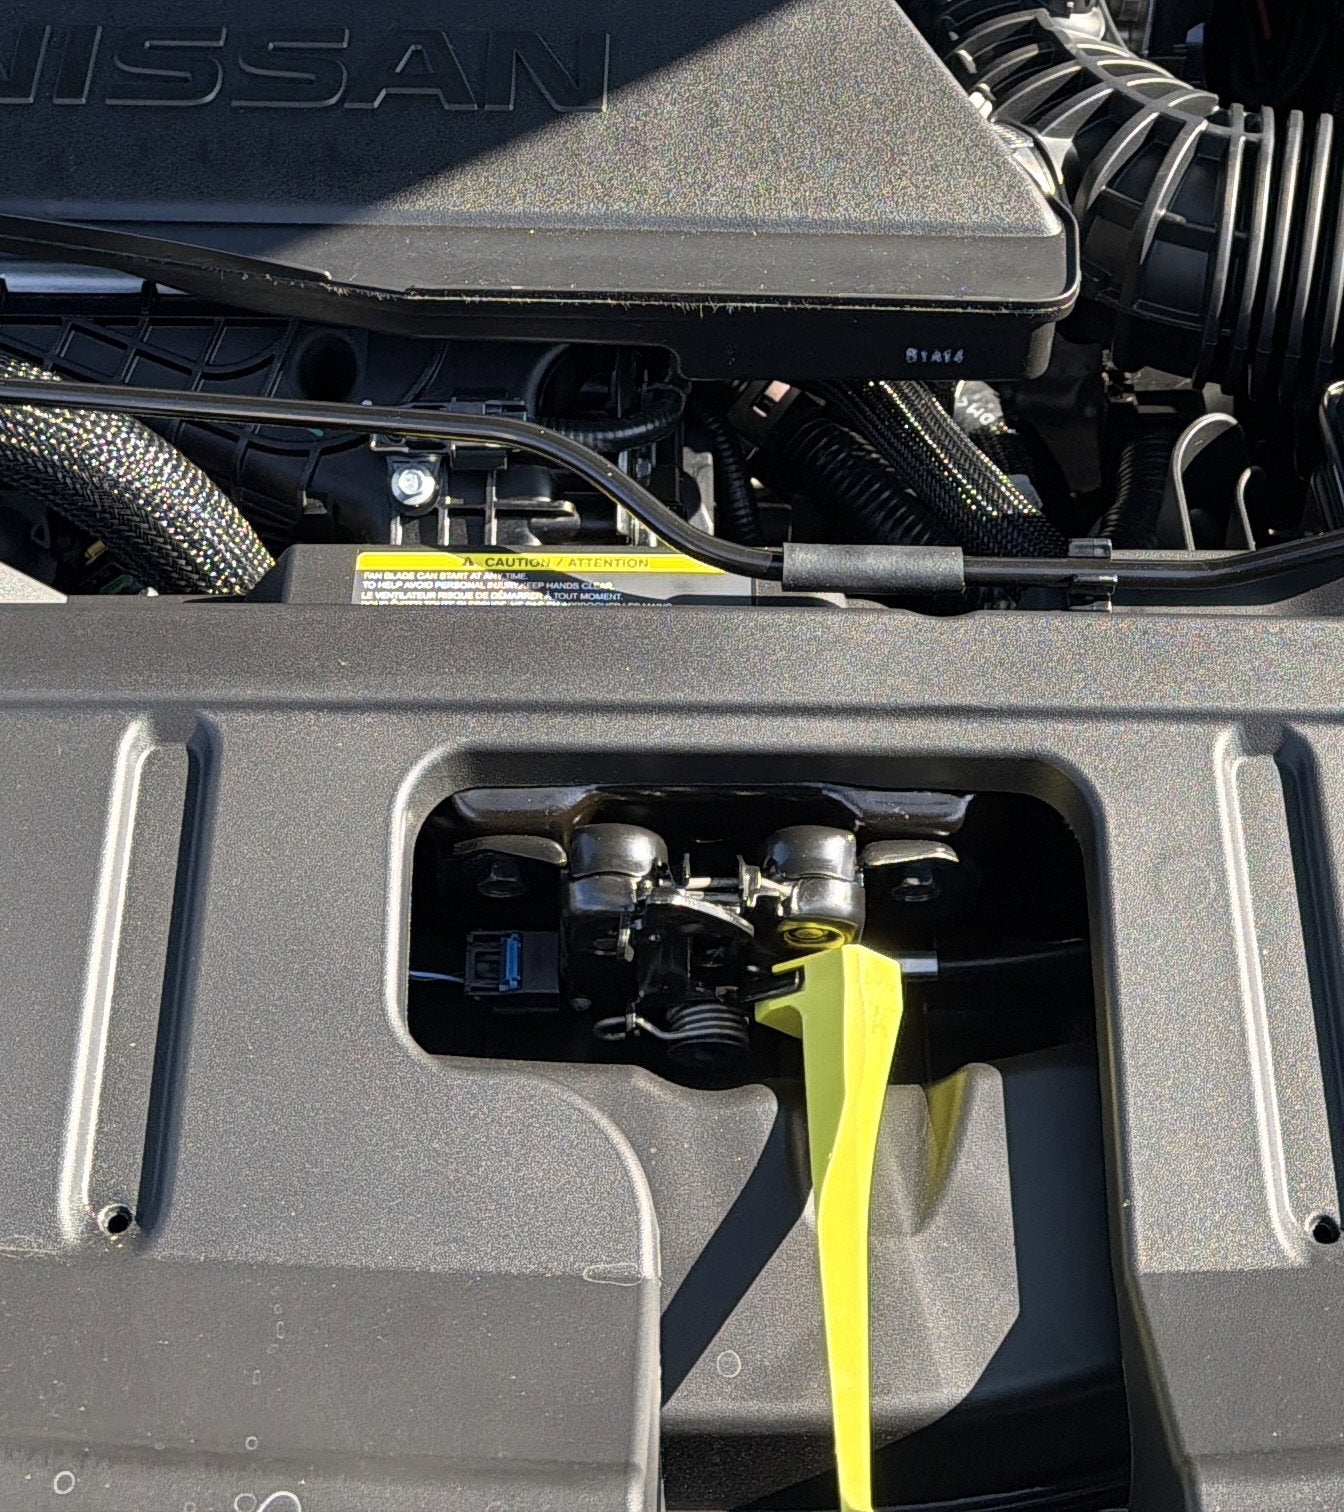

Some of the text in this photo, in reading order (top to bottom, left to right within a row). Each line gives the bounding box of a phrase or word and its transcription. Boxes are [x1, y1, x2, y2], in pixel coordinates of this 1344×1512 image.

[485, 557, 550, 567] CAUTION
[568, 558, 649, 568] ATTENTION
[363, 571, 382, 580] FAN
[384, 571, 415, 580] BLADE
[416, 571, 438, 580] CAN
[439, 571, 469, 580] START
[470, 572, 481, 580] AT
[362, 581, 376, 589] TO
[377, 581, 403, 589] HELP
[404, 581, 434, 589] AVOID
[435, 581, 486, 590] PERSONAL
[545, 582, 579, 590] HANDS
[490, 590, 544, 600] DÉMARRER
[554, 592, 577, 600] TOUT
[580, 592, 623, 600] MOMENT.
